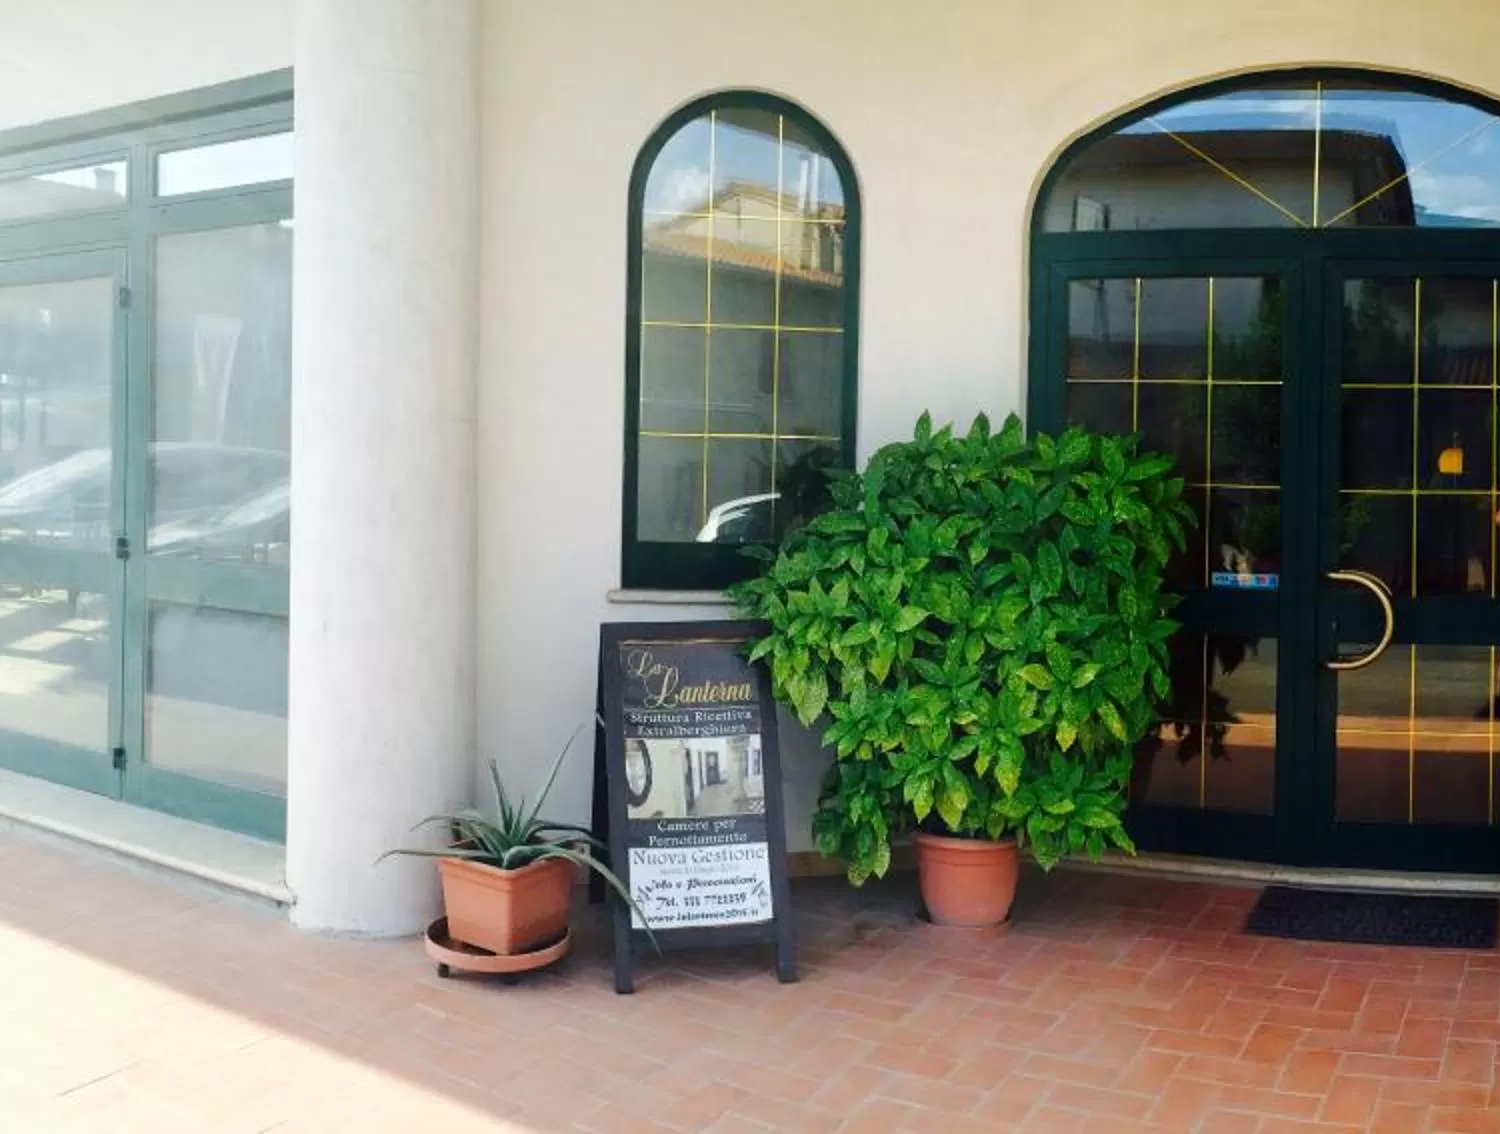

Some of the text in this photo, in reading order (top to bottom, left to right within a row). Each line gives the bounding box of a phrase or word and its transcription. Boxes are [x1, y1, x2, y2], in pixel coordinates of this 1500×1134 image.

[644, 665, 752, 708] Lanterna
[630, 708, 752, 724] Struttura Ricettiva
[657, 817, 737, 832] Camere per
[633, 847, 766, 866] Nuova Gestione
